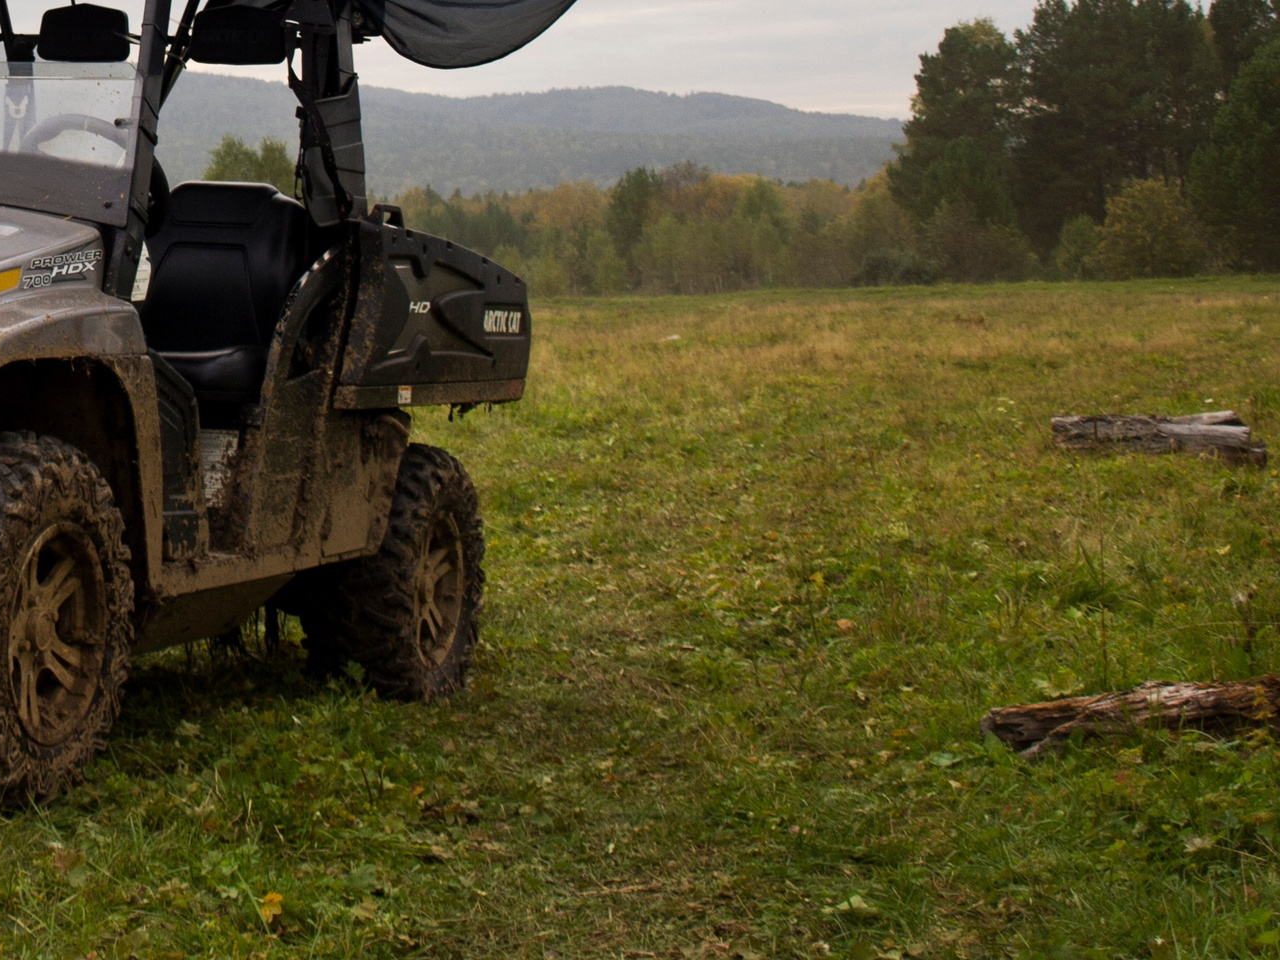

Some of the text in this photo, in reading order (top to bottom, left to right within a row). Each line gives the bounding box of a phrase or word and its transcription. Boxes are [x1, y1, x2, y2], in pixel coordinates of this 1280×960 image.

[31, 249, 102, 269] PROWLER
[52, 261, 97, 278] HDX
[23, 274, 52, 289] 700
[409, 301, 431, 314] HD
